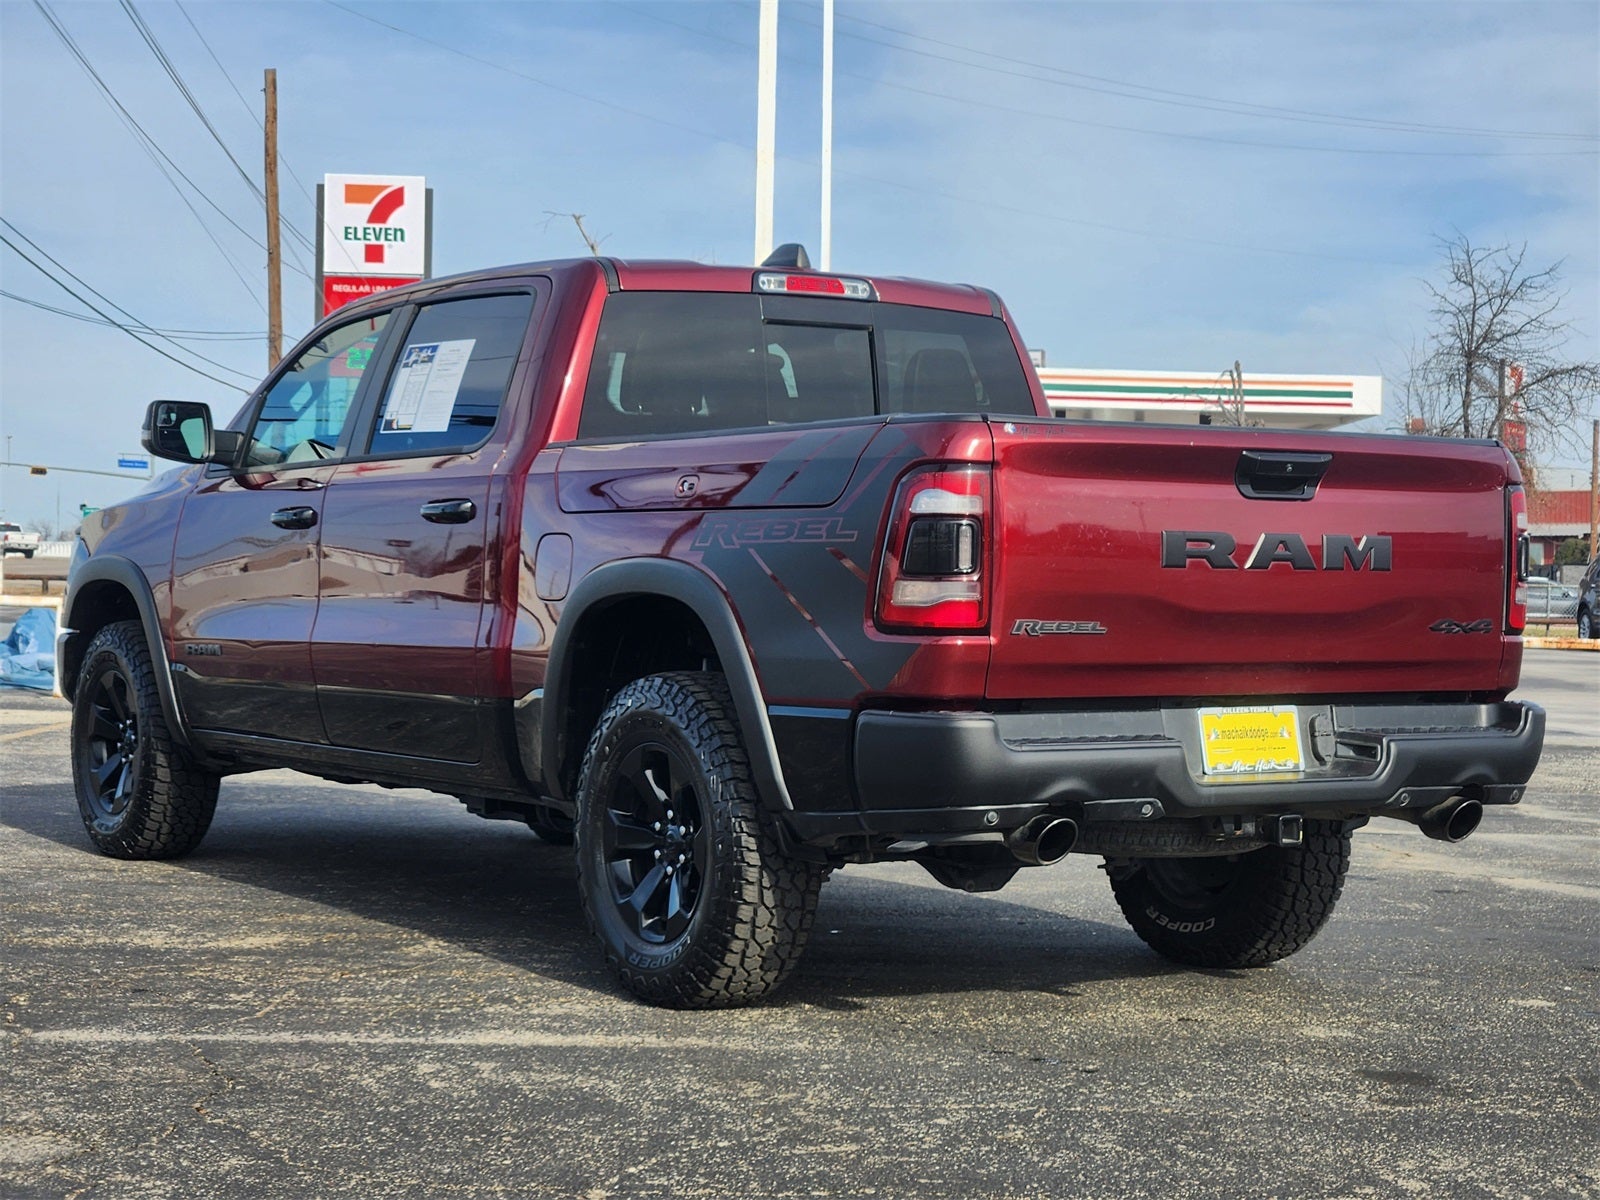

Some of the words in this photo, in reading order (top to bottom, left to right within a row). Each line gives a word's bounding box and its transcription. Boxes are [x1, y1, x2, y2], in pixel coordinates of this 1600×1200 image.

[332, 284, 370, 293] REGULAR
[695, 517, 857, 548] REBEL
[1161, 530, 1393, 572] RAM
[1010, 619, 1108, 636] REBEL
[186, 643, 222, 656] RAM
[1146, 905, 1215, 933] COOPER
